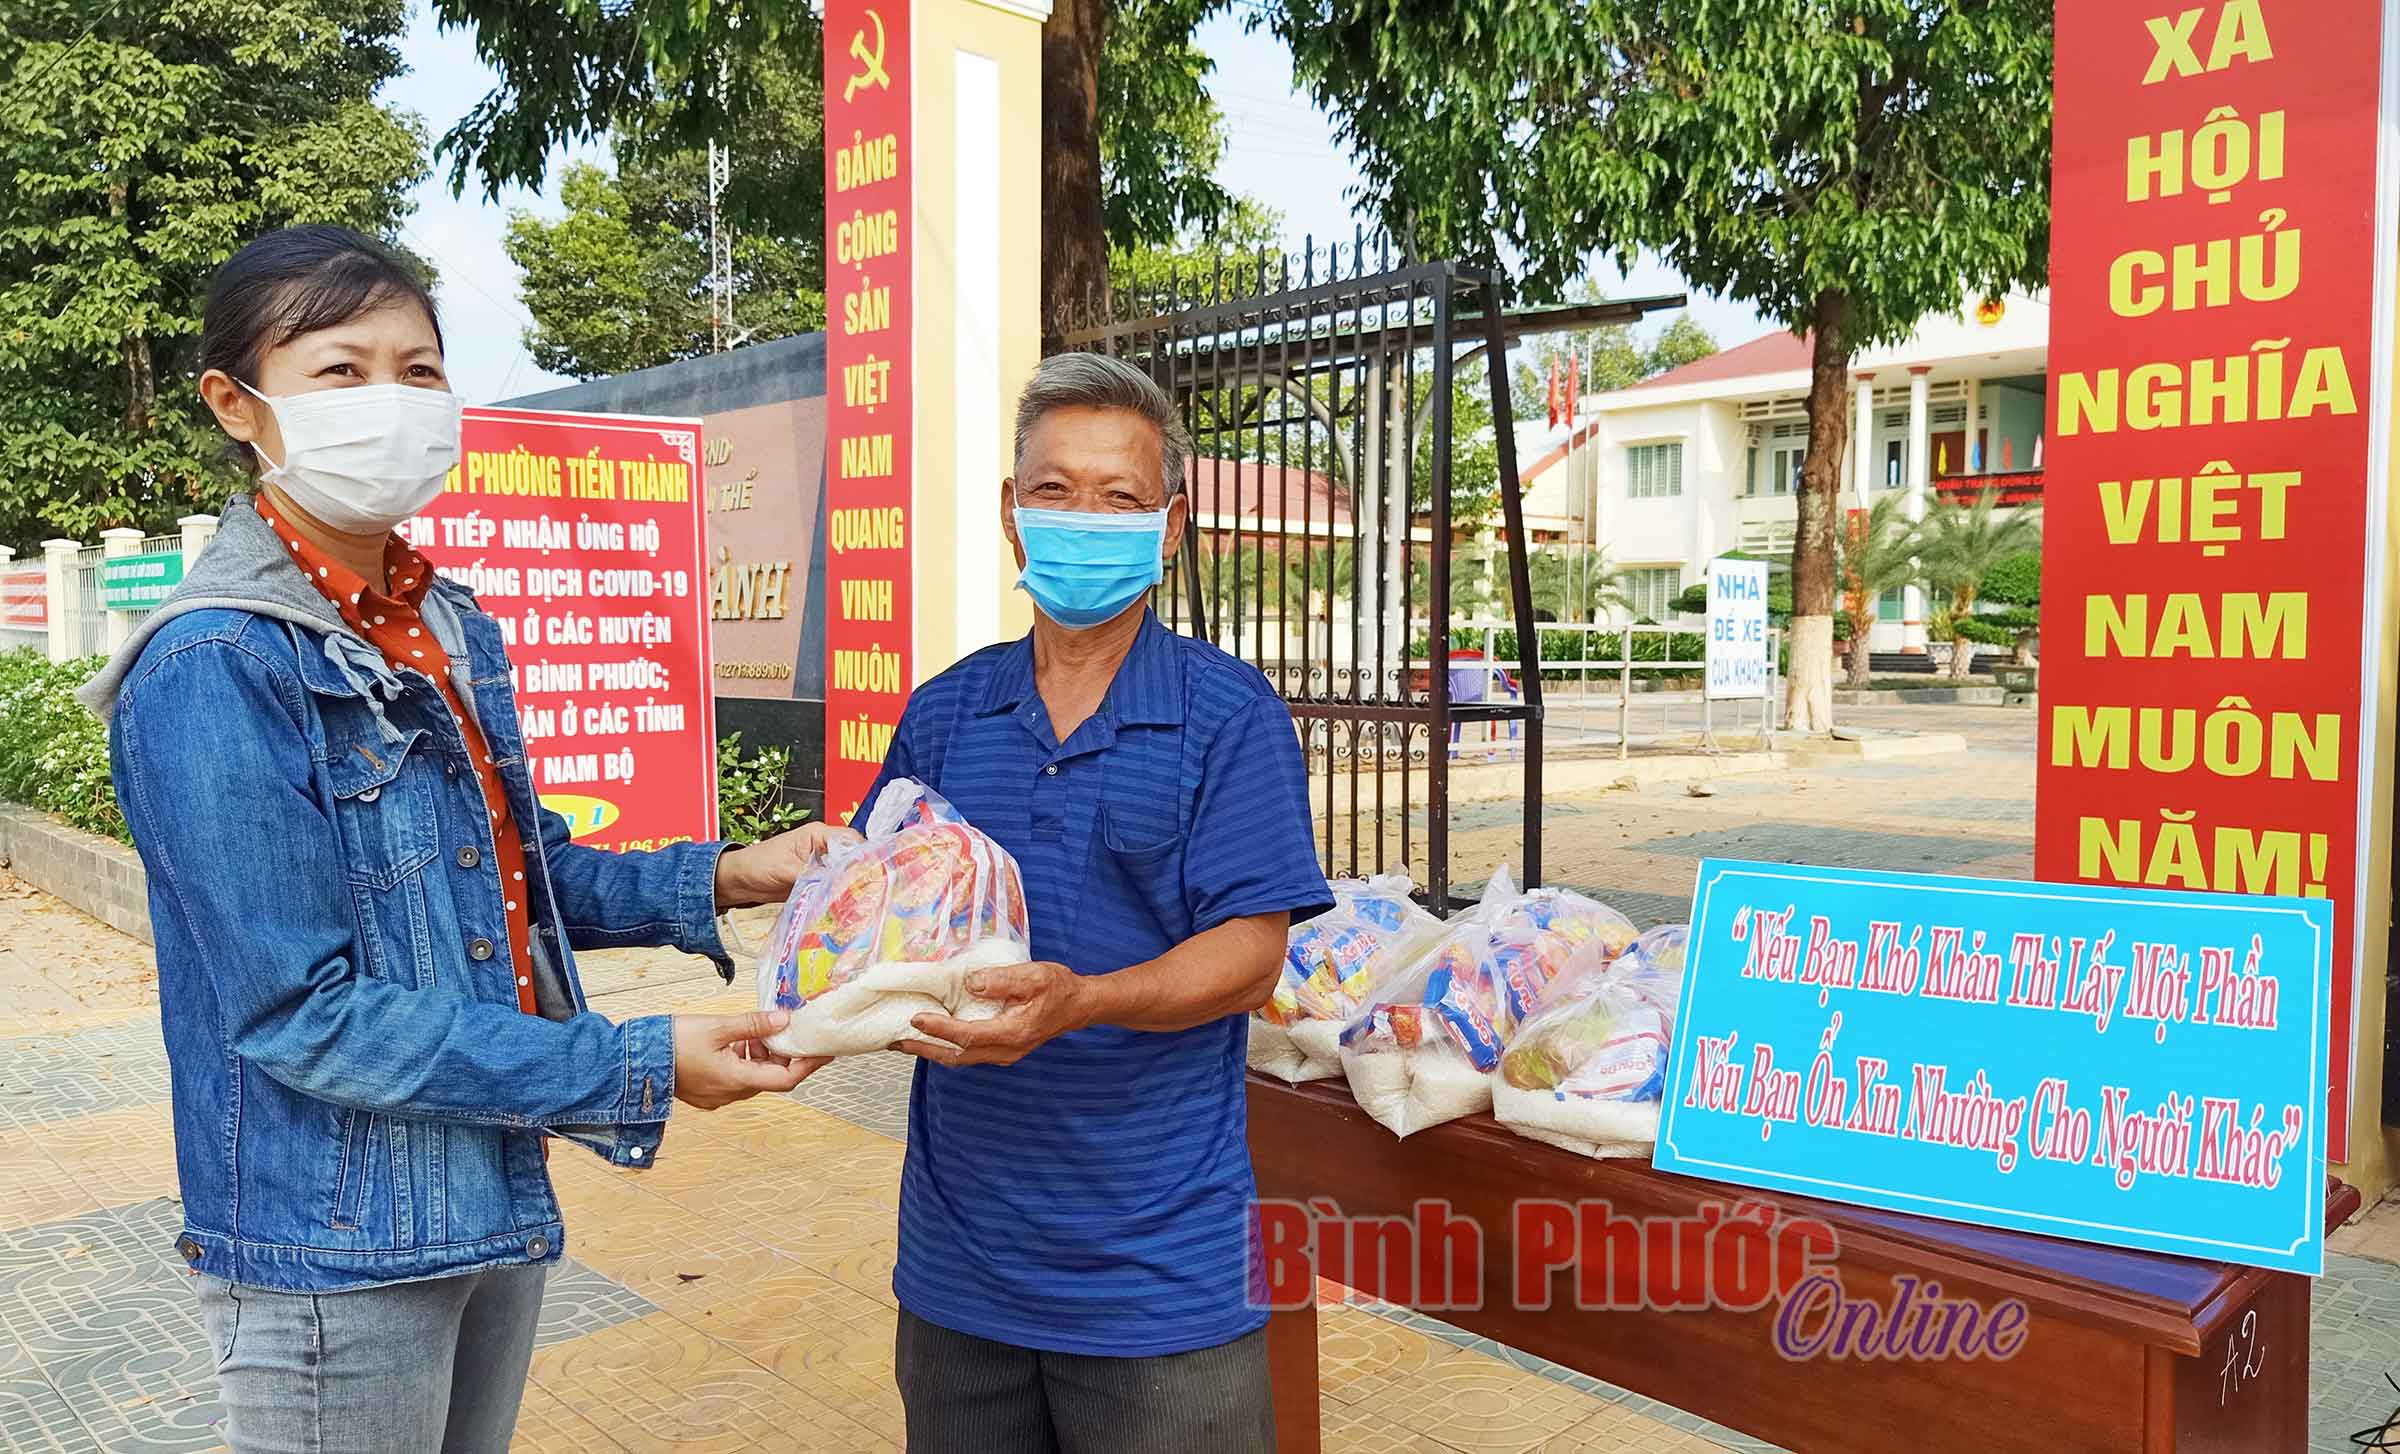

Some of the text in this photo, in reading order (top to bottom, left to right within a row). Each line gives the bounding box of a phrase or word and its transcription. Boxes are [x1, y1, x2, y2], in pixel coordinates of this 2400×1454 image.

[836, 130, 897, 192] ĐẢNG
[2126, 105, 2285, 205] HỘI
[837, 210, 897, 270] CỘNG
[2109, 208, 2300, 317] CHỦ
[844, 277, 890, 335] SẢN
[844, 355, 890, 413] VIỆT
[2057, 337, 2357, 436] NGHĨA
[468, 444, 561, 498] PHƯỜNG
[567, 446, 616, 500] TIẾN
[620, 454, 689, 503] THÀNH
[841, 434, 893, 479] NAM
[441, 510, 496, 548] TIẾP
[503, 515, 570, 556] NHẬN
[577, 513, 624, 551] ỦNG
[630, 518, 660, 558] HỘ
[831, 507, 904, 554] QUANG
[2098, 460, 2302, 557] VIỆT
[527, 568, 583, 603] DỊCH
[588, 570, 688, 598] COVID-19
[711, 545, 790, 619] ÀNH
[841, 580, 893, 622] VINH
[523, 608, 540, 645] Ở
[546, 611, 593, 645] CÁC
[599, 611, 671, 649] HUYỆN
[1743, 618, 1762, 641] XE
[2084, 591, 2308, 659] NAM
[525, 659, 582, 693] BÌNH
[834, 643, 900, 694] MUÔN
[519, 697, 685, 744] ẶN Ở CÁC TỈNH
[840, 713, 897, 764] NĂM
[2051, 696, 2341, 782] MUÔN
[543, 753, 598, 784] NAM
[604, 747, 634, 784] BỘ
[2079, 808, 2328, 900] NĂM!
[1800, 915, 1857, 1008] Bạn
[1859, 921, 1921, 995] Khó
[1920, 928, 2001, 1003] Khăn
[2006, 932, 2061, 1010] Thì
[2061, 928, 2124, 1033] Lấy
[2125, 941, 2190, 1043] Một
[2192, 933, 2279, 1030] Phần
[1684, 1031, 1745, 1114] Nếu
[1743, 1045, 1801, 1141] Bạn
[1804, 1010, 1847, 1127] Ổn
[1847, 1056, 1900, 1136] Xin
[1902, 1063, 2025, 1174] Nhường
[2028, 1077, 2091, 1165] Cho
[2092, 1085, 2196, 1191] Người
